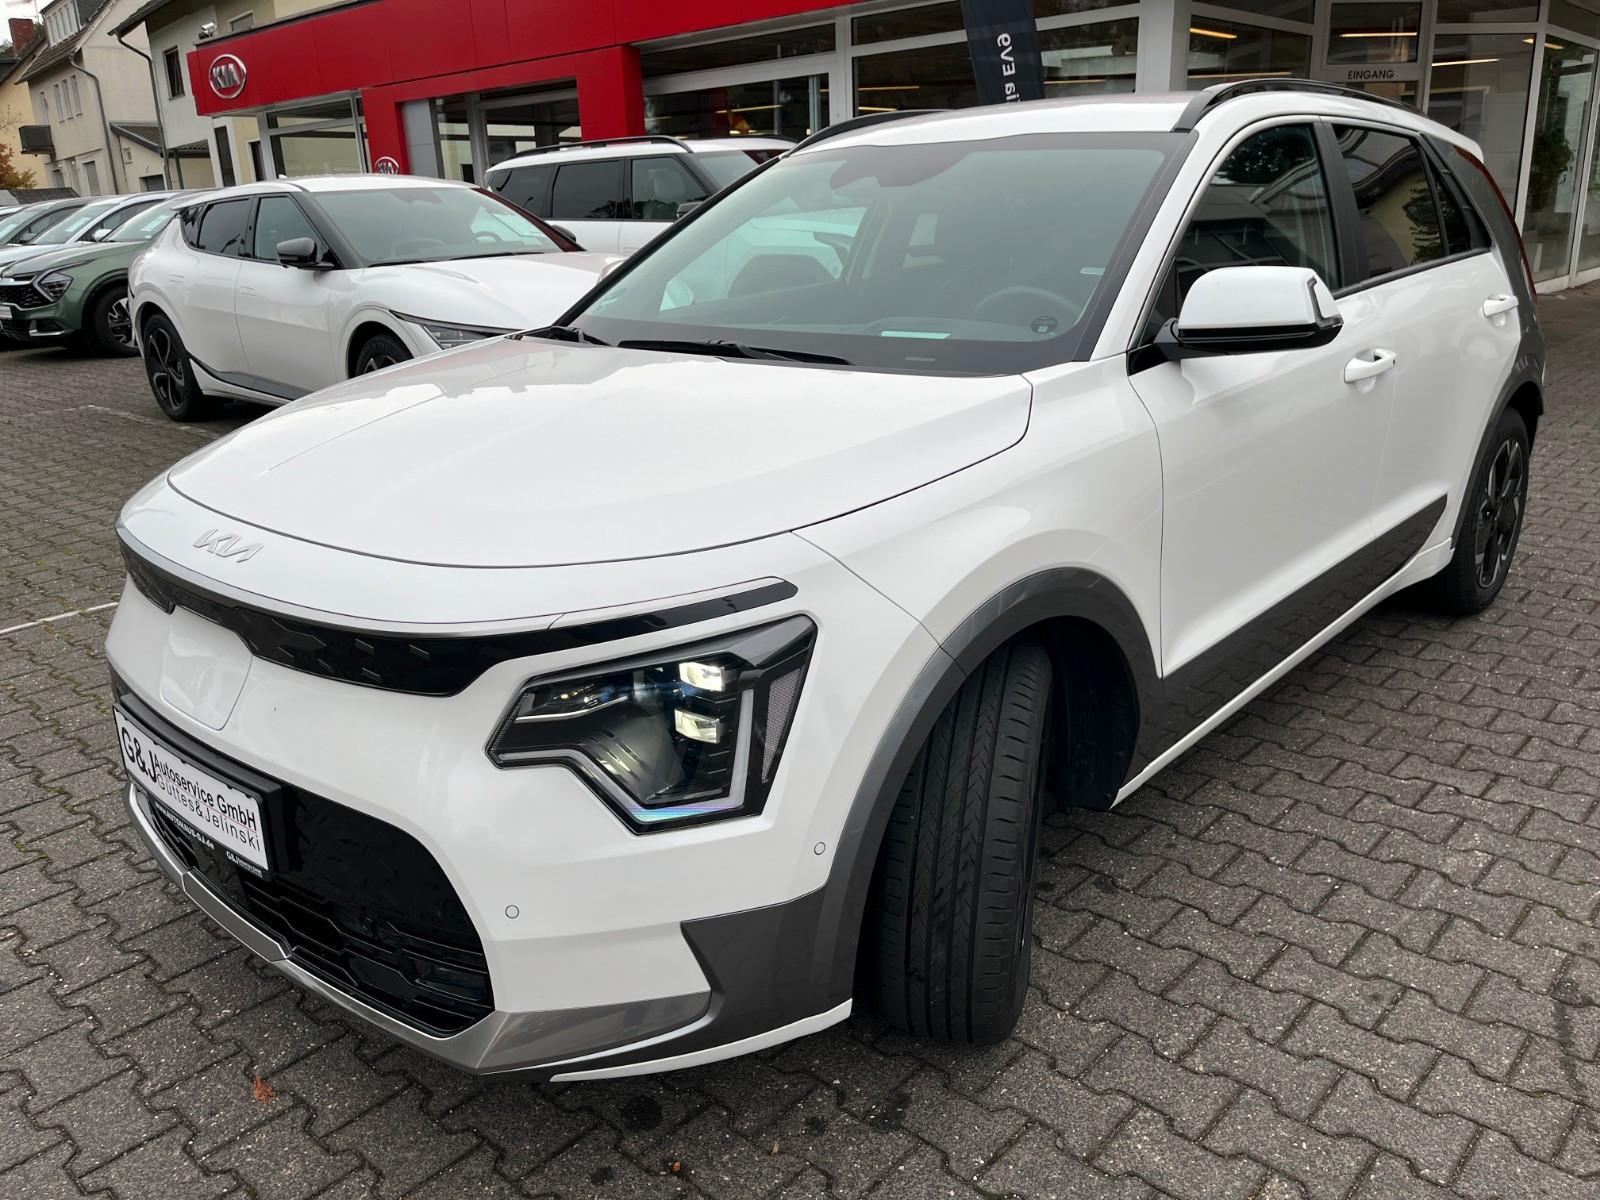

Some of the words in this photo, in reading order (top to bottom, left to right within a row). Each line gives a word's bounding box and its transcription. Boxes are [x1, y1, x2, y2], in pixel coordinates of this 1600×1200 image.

[211, 62, 241, 91] KIA
[1347, 69, 1394, 80] EINGANG
[121, 726, 157, 783] G&J
[154, 753, 214, 807] Autoservice
[217, 794, 257, 831] GmbH
